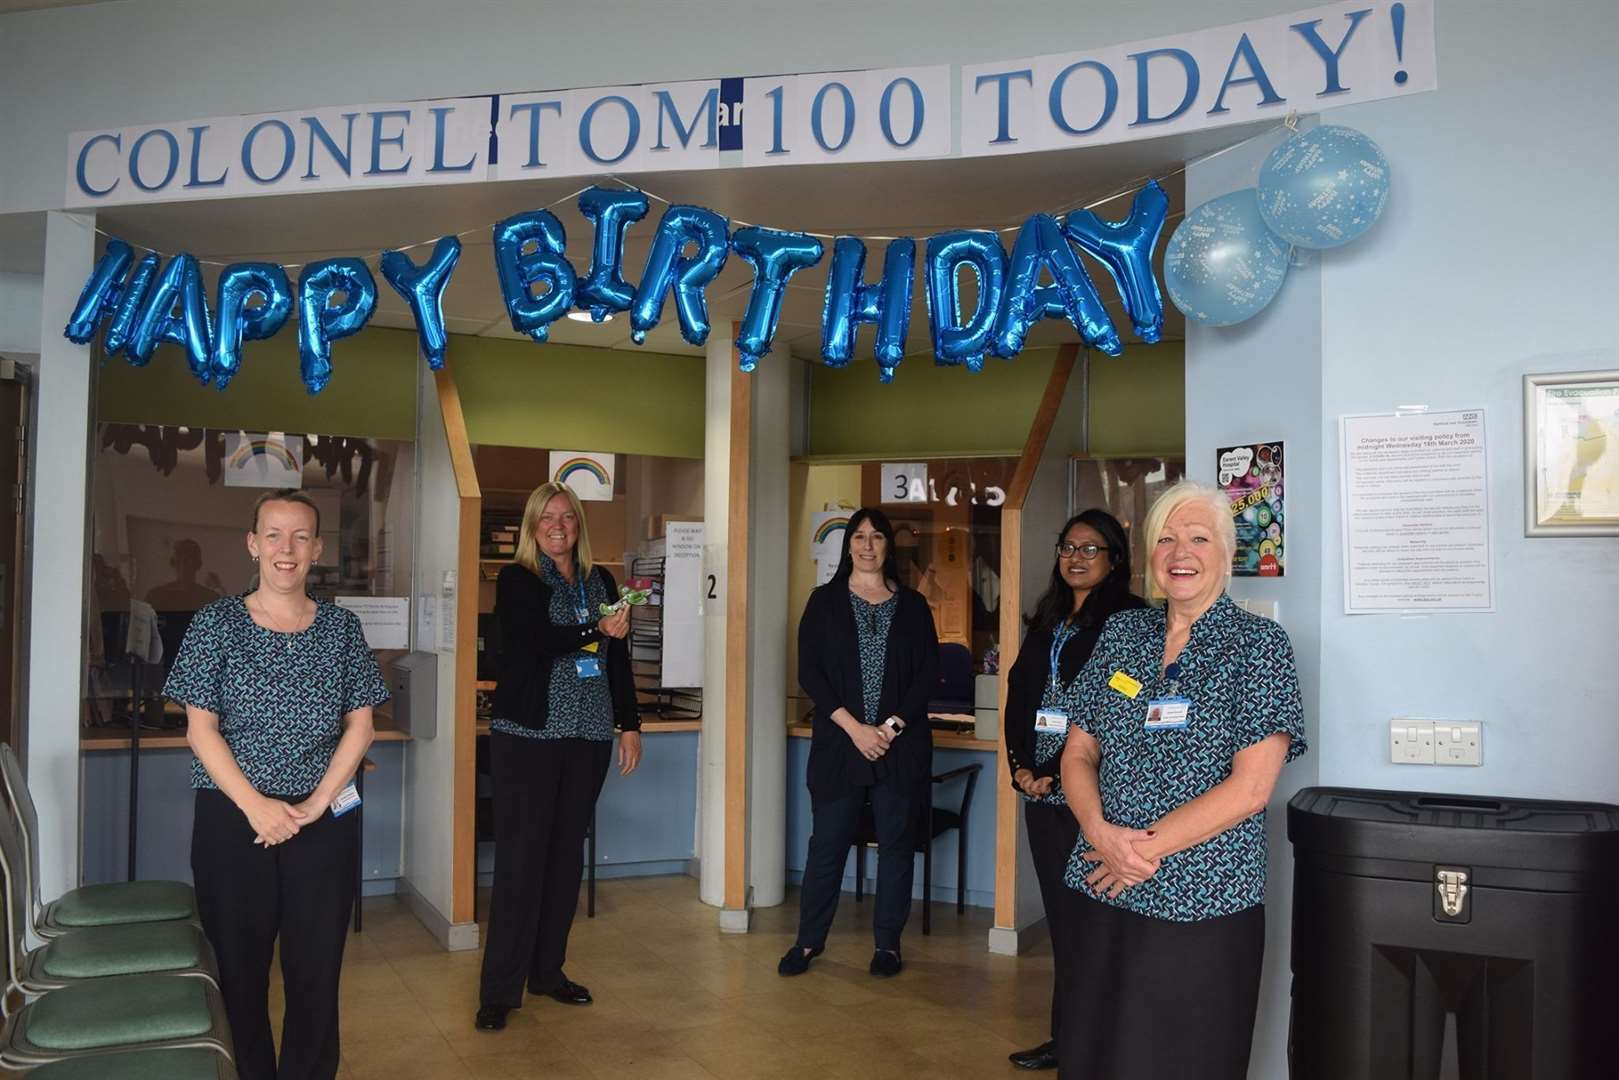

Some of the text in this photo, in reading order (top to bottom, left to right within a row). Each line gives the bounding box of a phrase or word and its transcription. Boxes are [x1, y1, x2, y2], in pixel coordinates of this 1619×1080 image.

[76, 2, 1408, 198] COLONEL TOM 100 TODAY!
[64, 177, 1169, 396] HAPPY BIRTHDAY
[1410, 434, 1433, 442] visiting
[894, 474, 909, 499] 3
[707, 574, 717, 600] 2
